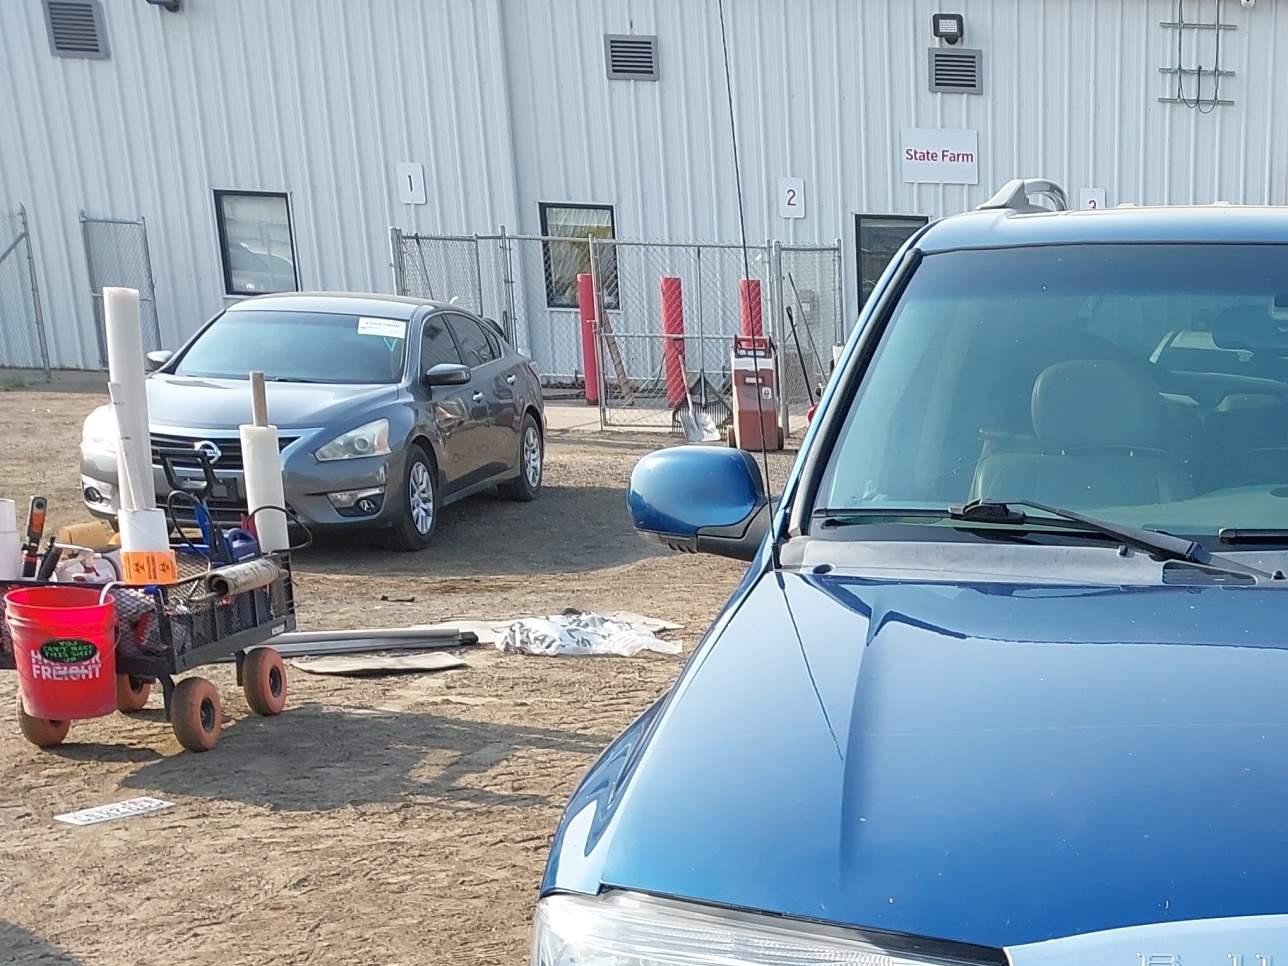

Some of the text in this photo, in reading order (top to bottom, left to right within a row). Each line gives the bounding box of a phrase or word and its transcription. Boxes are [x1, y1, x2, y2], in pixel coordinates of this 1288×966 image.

[905, 148, 974, 163] State Farm
[407, 174, 413, 191] 1
[787, 188, 797, 206] 2
[32, 664, 102, 680] FREIGHT
